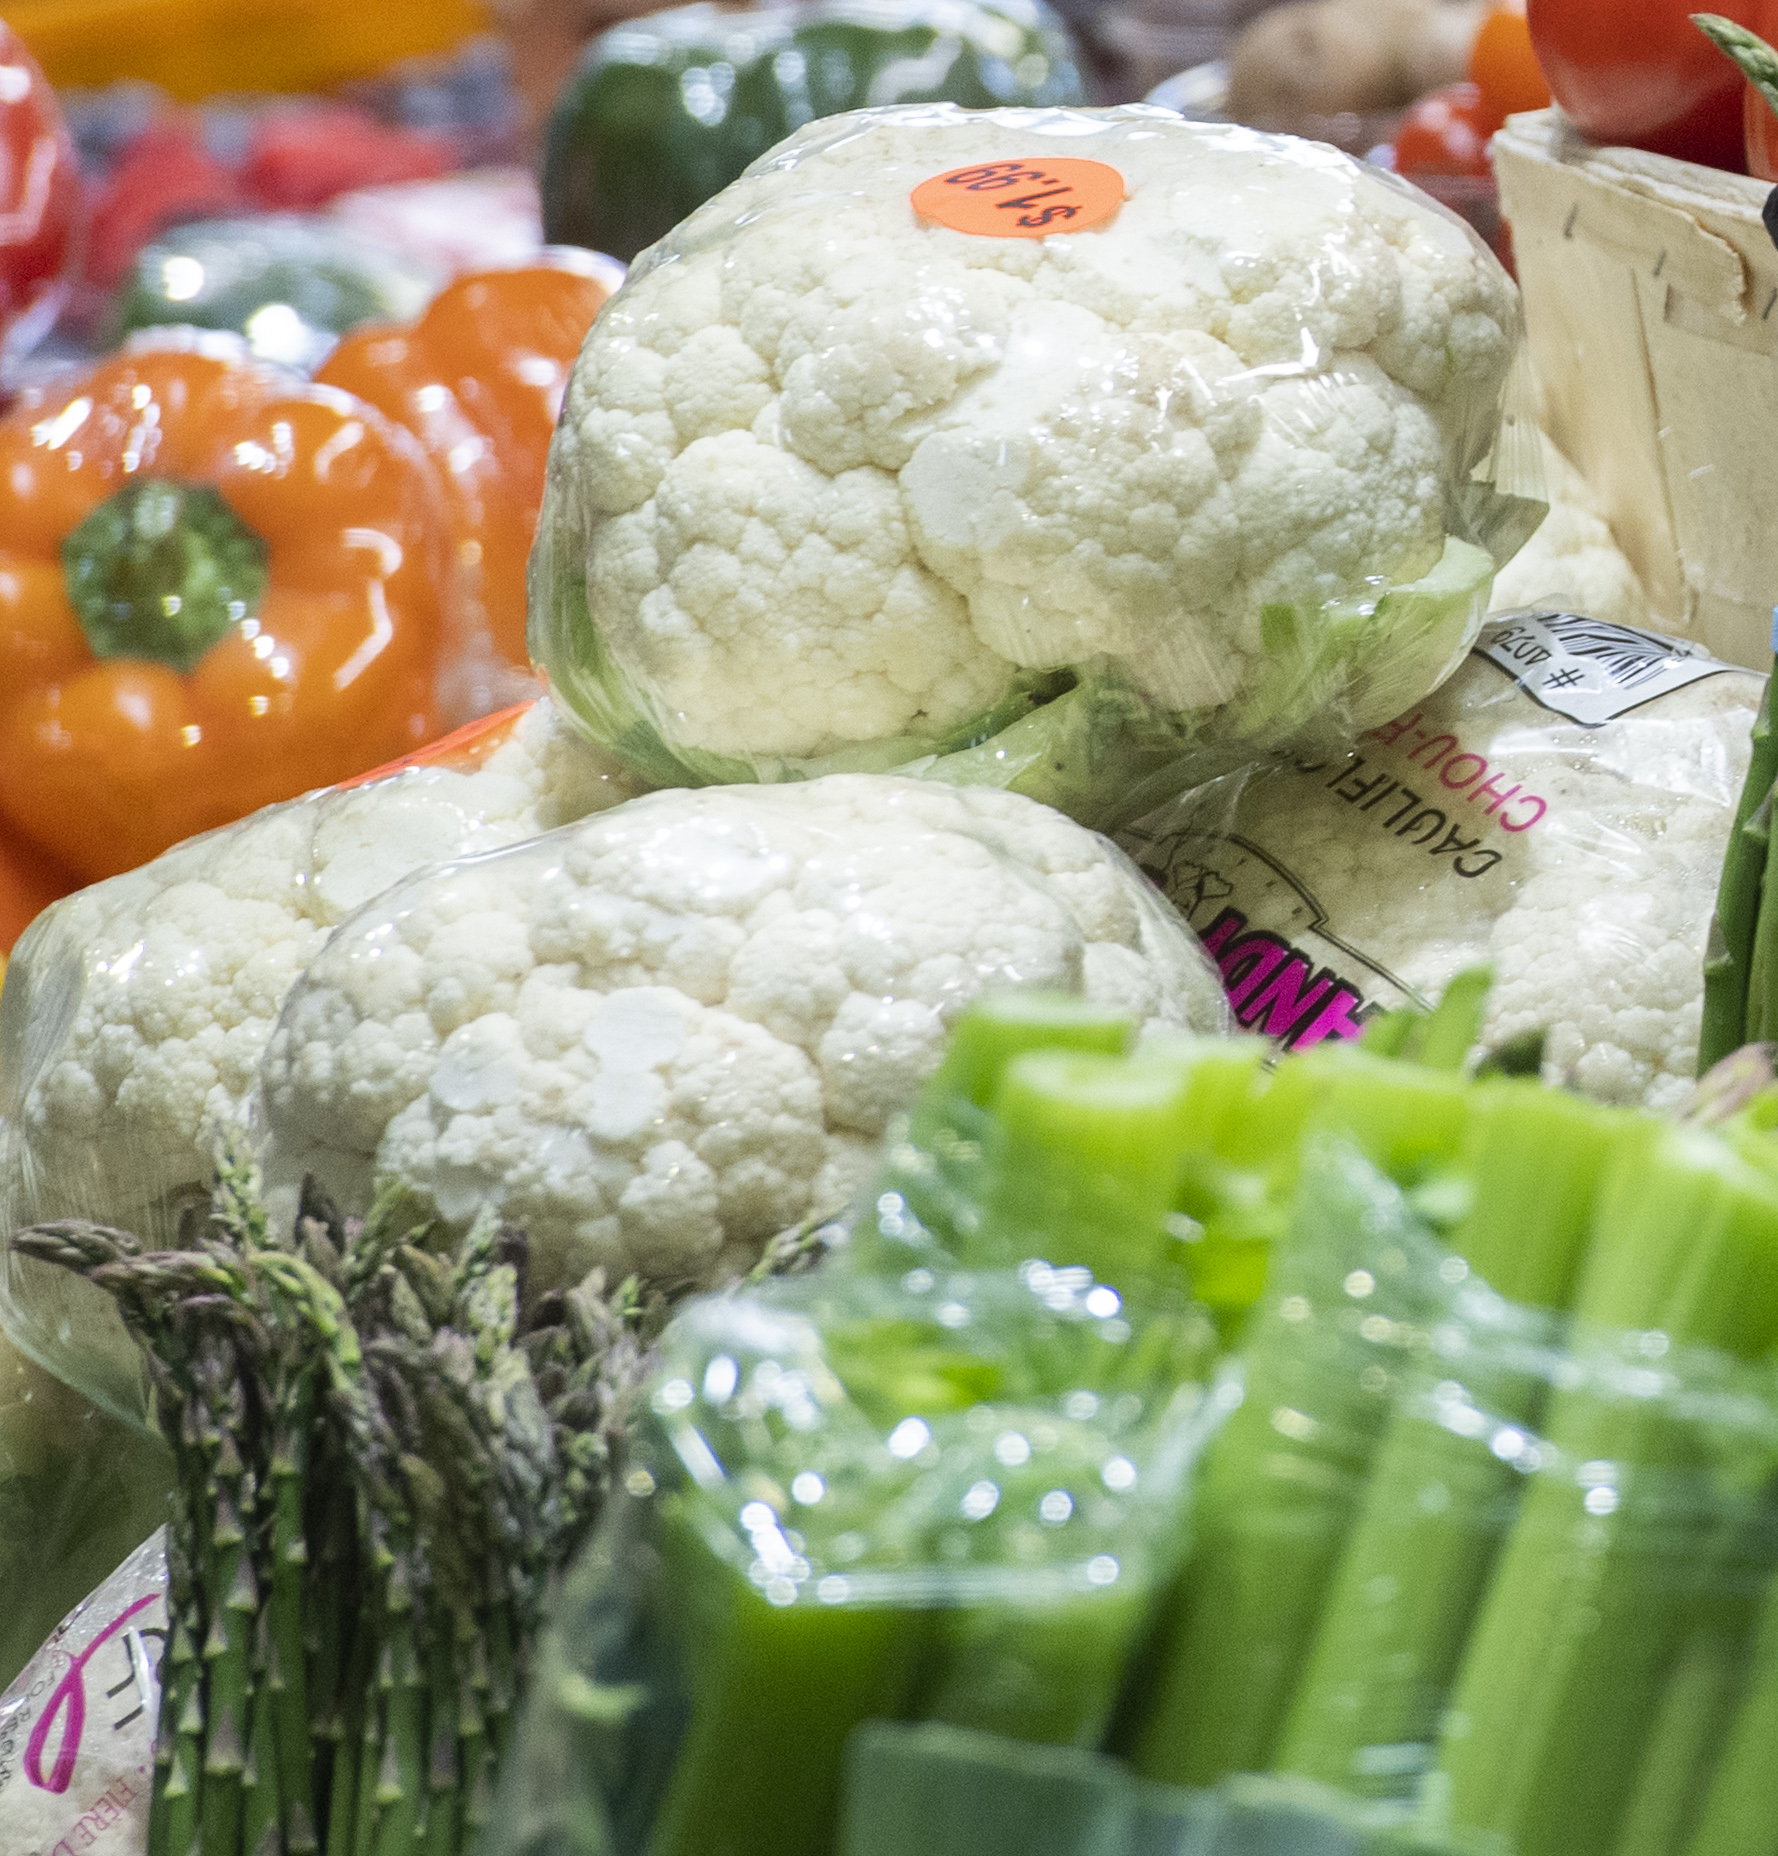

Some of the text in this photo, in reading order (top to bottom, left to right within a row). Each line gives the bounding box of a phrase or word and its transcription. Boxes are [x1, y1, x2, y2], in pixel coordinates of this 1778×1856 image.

[944, 163, 1083, 228] $1.99
[1492, 626, 1552, 666] 4079
[1275, 748, 1502, 878] CAULIFL
[1372, 713, 1547, 832] CHOU-F
